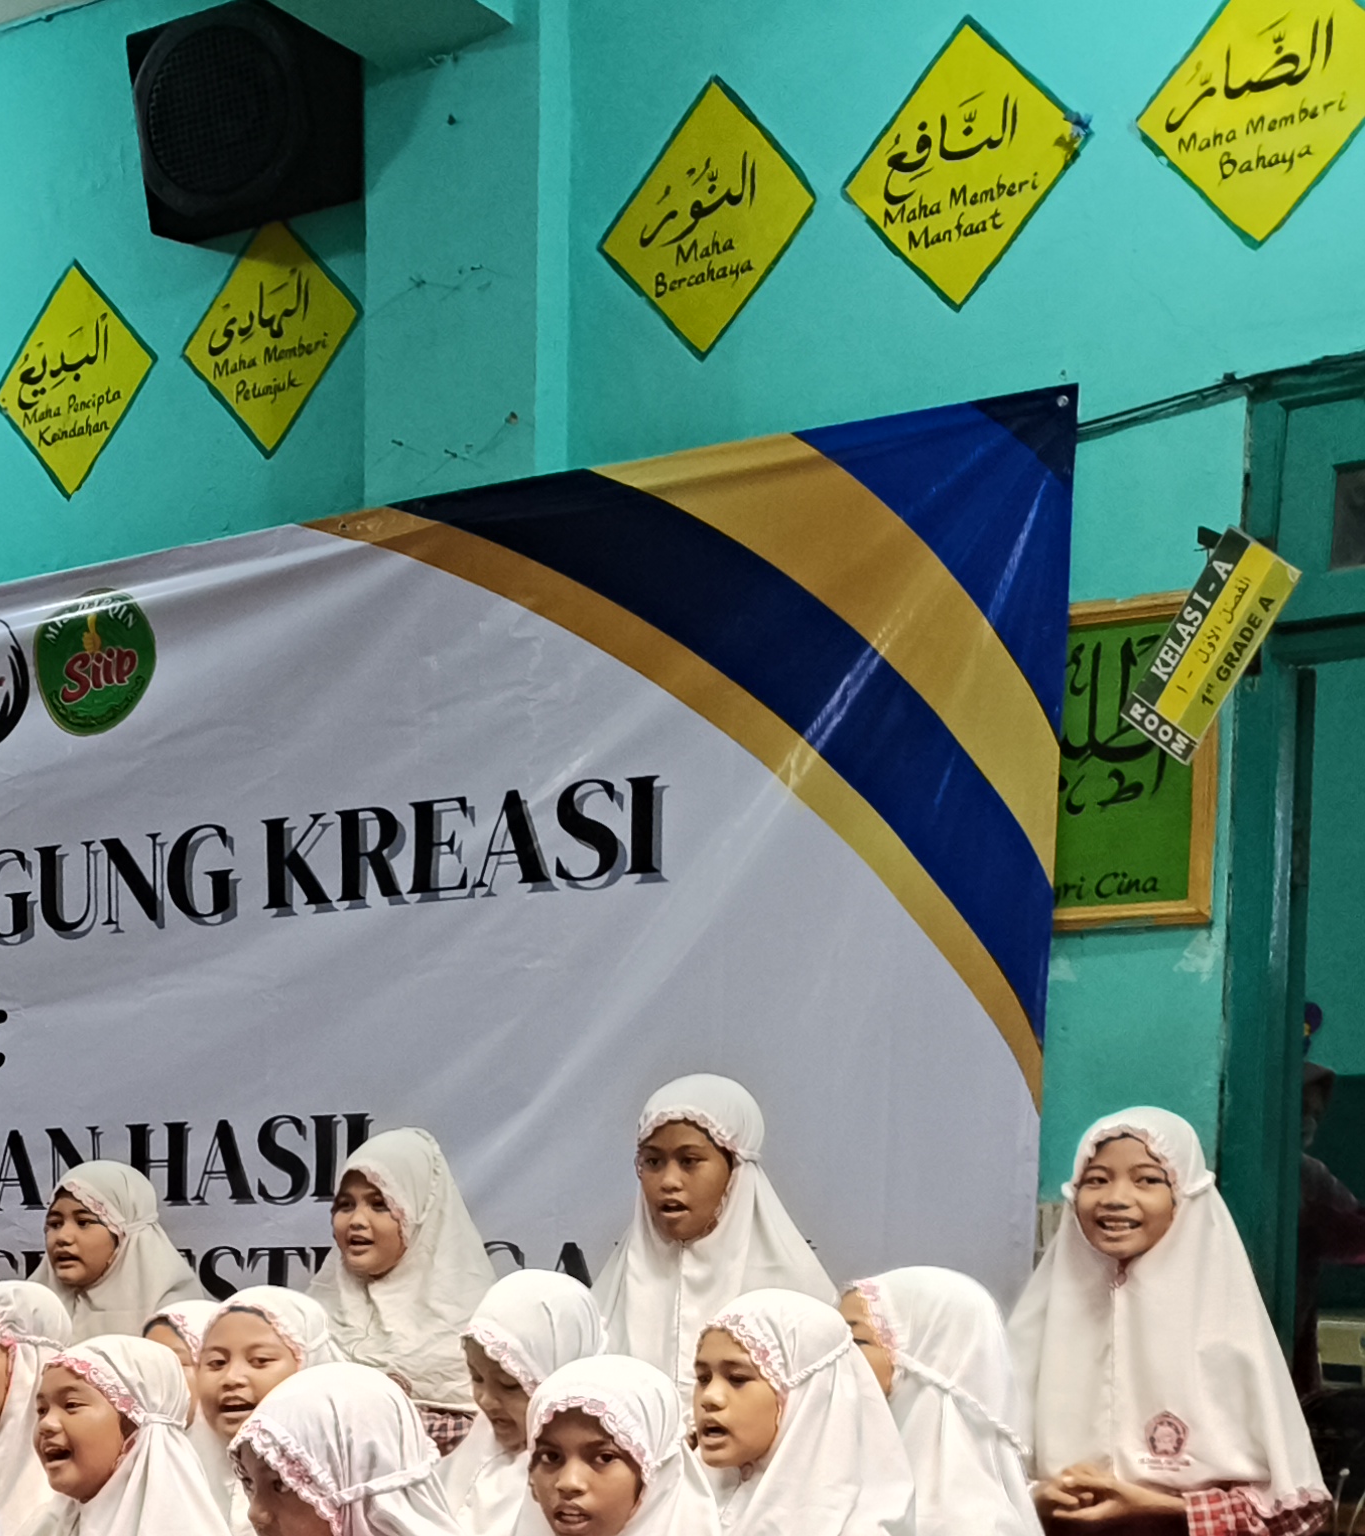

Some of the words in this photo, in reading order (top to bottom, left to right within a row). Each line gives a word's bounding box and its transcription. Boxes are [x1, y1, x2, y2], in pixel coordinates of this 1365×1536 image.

[1176, 125, 1238, 155] Maha
[1245, 90, 1349, 139] Memberi
[1217, 140, 1314, 187] Bahaya
[882, 196, 942, 229] Maha
[948, 170, 1040, 211] Memberi
[675, 229, 735, 266] Maha
[907, 208, 1005, 253] Manfaat
[654, 257, 754, 298] Bercahaya
[212, 354, 257, 381] Maha
[263, 331, 330, 366] Memberi
[21, 403, 62, 427] Maha
[67, 386, 122, 415] Pencipta
[234, 371, 303, 405] Petunjuk
[37, 417, 111, 447] Keindahan
[1149, 606, 1207, 683] KELAS
[1211, 559, 1235, 585] A
[1216, 616, 1264, 683] GRADE
[1256, 593, 1277, 615] A
[1129, 701, 1190, 757] ROOM
[262, 774, 669, 918] KREASI
[1093, 871, 1159, 900] Cina
